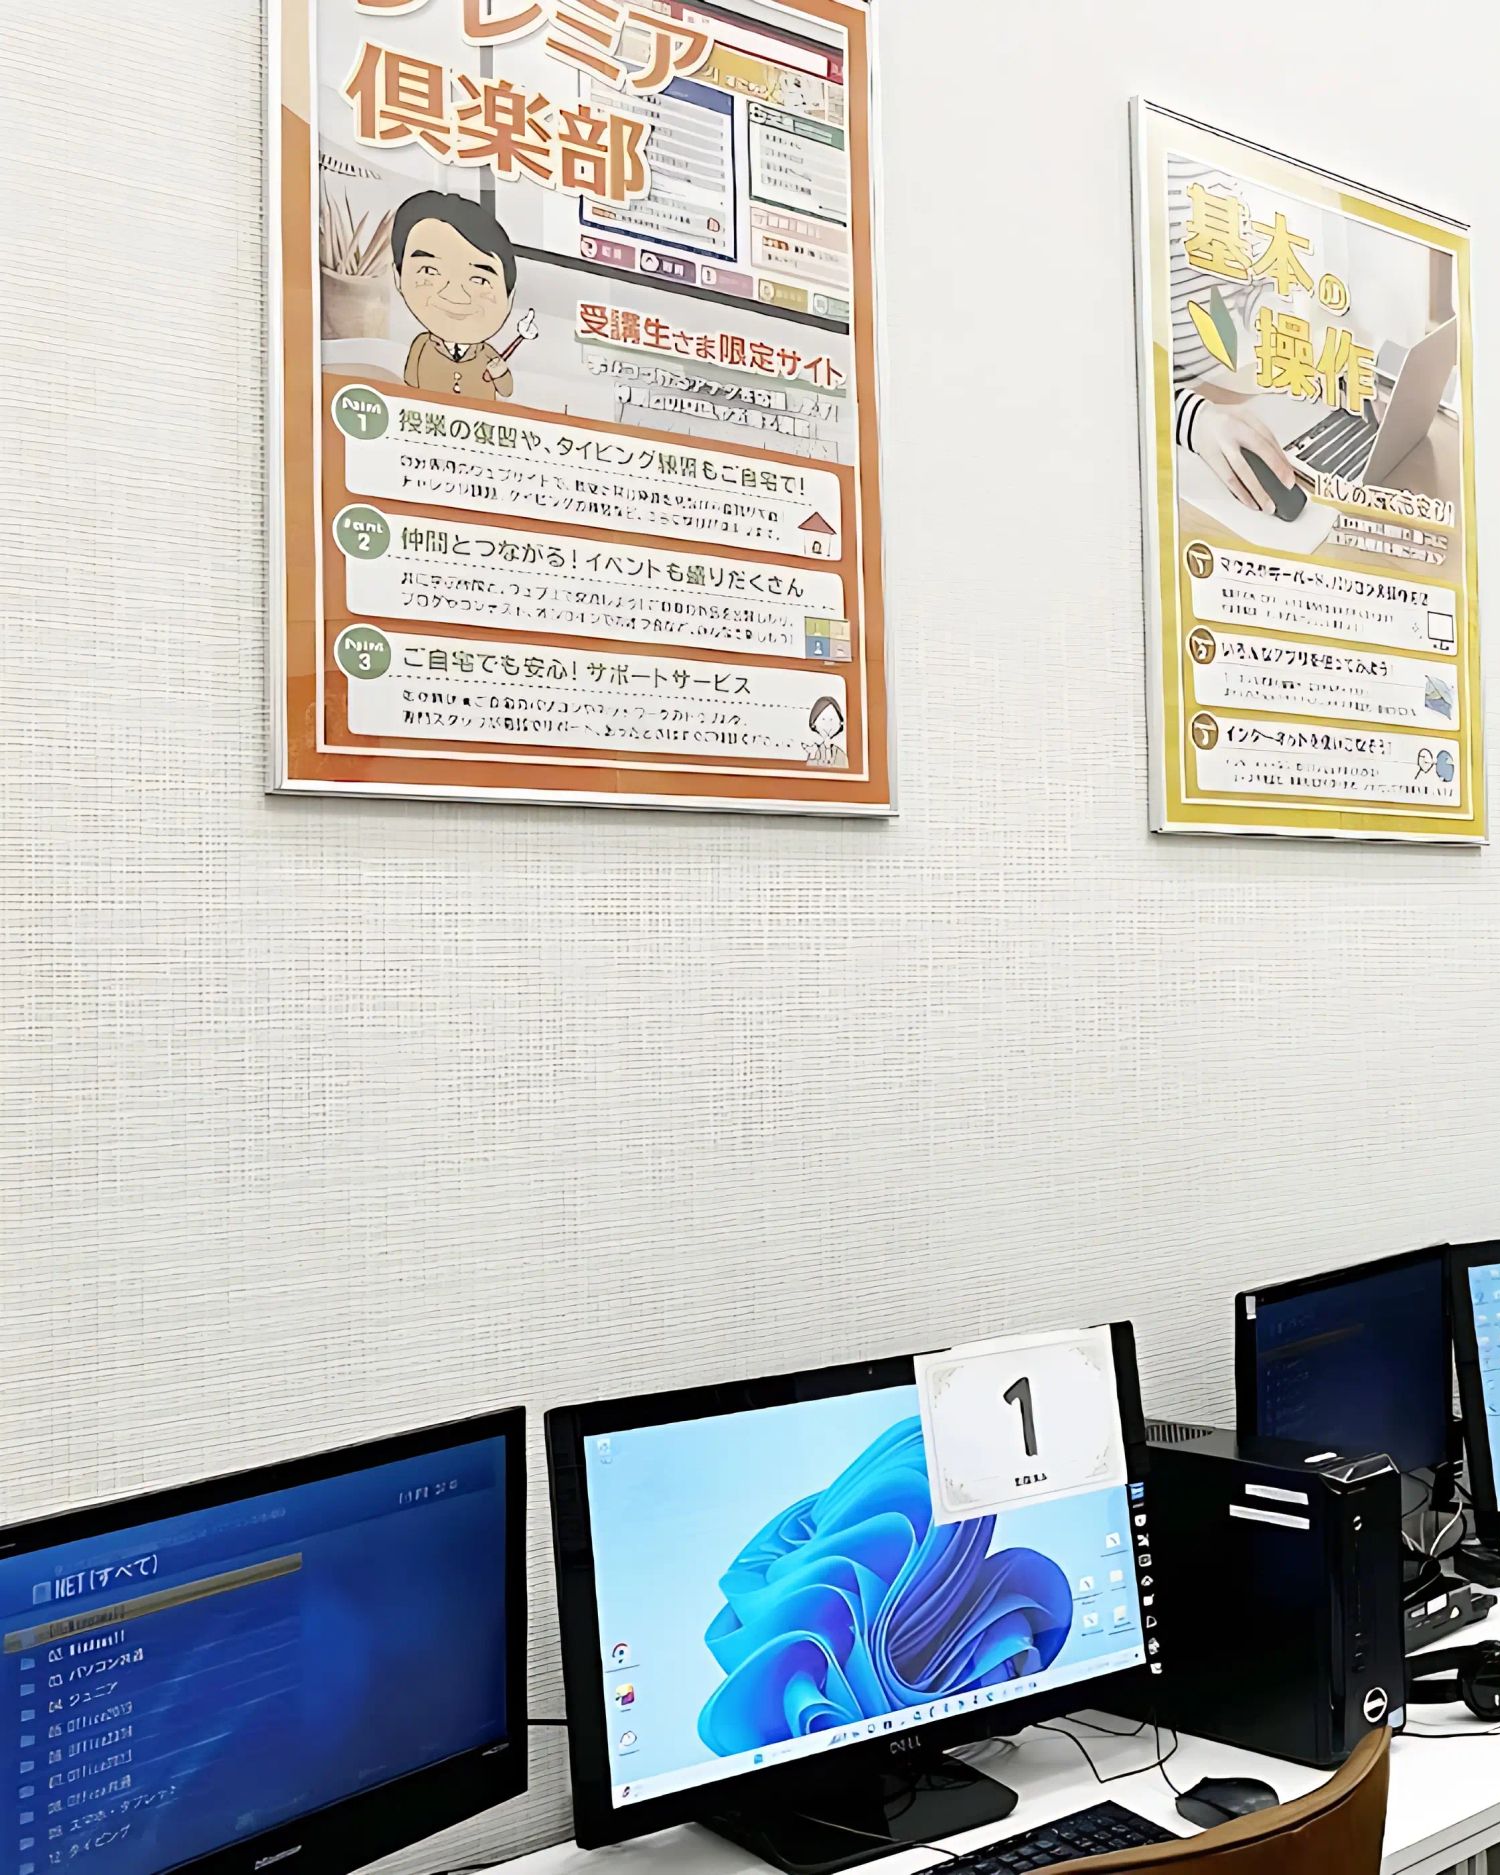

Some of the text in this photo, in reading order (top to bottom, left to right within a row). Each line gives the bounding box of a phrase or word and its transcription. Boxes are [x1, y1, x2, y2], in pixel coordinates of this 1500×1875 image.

[345, 42, 652, 201] 倶楽部
[579, 302, 844, 386] 受講生さま限定サイト
[1253, 306, 1377, 413] 操作
[356, 415, 369, 432] 1
[357, 533, 371, 551] 2
[358, 653, 372, 671] 3
[1002, 1376, 1038, 1457] 1
